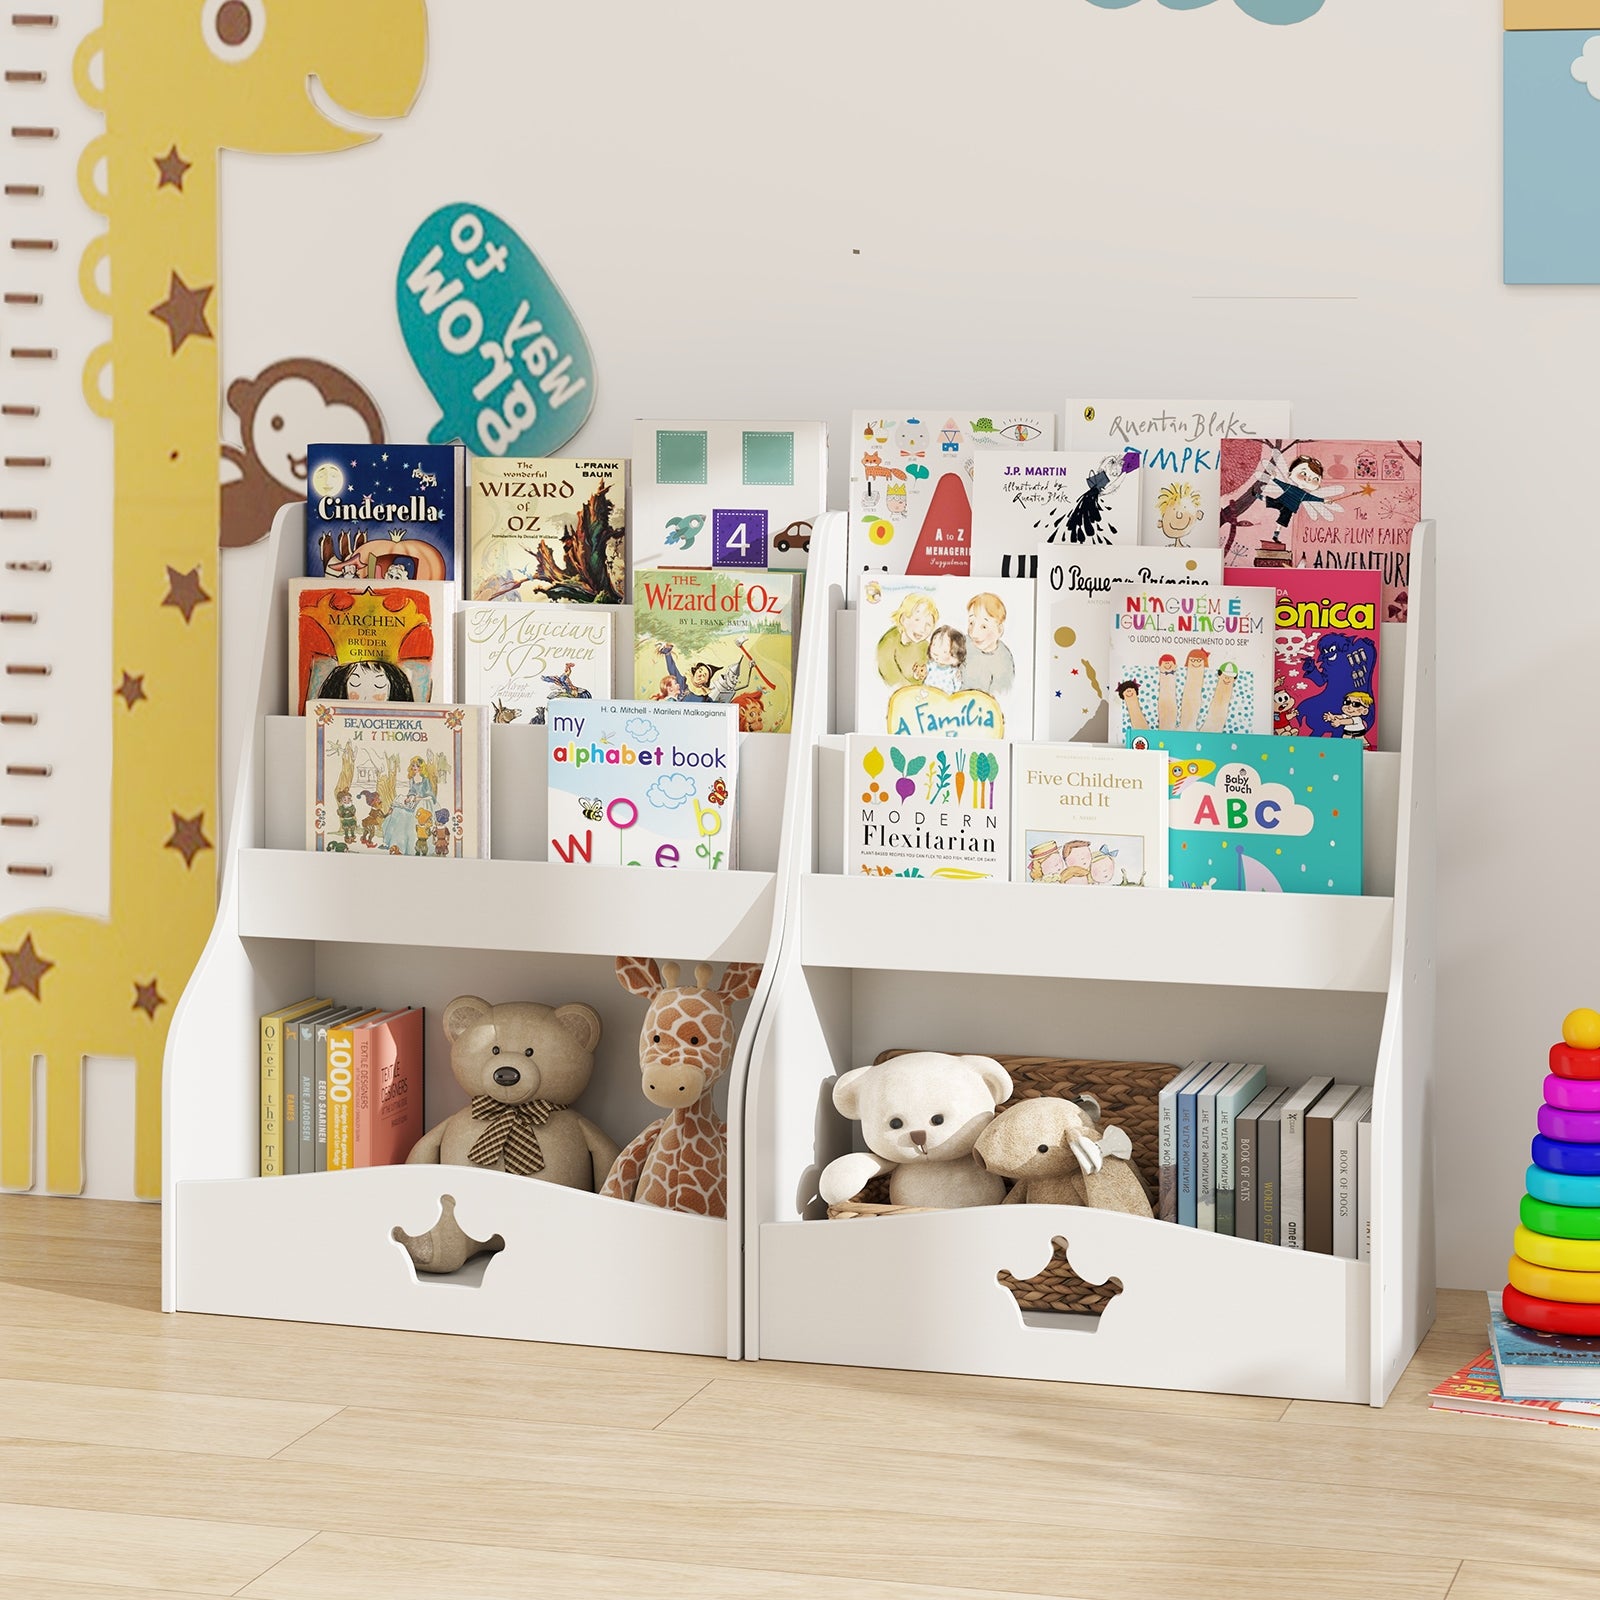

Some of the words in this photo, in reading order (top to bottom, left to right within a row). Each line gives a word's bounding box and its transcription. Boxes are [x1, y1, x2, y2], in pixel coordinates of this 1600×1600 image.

[1109, 410, 1188, 442] Quentin
[1185, 411, 1257, 442] Blake
[1004, 466, 1021, 476] J.P.
[1025, 467, 1067, 476] MARTIN
[318, 496, 438, 522] Cinderella
[517, 502, 531, 512] of
[1012, 492, 1045, 509] Quentin
[1041, 491, 1071, 505] Blake
[1354, 506, 1368, 520] The
[507, 516, 541, 532] OZ
[726, 523, 750, 557] 4
[935, 528, 943, 541] A
[957, 528, 965, 541] Z
[1303, 526, 1341, 544] SUGAR
[1344, 527, 1374, 545] PLUM
[925, 546, 971, 556] MENAGERI
[672, 576, 700, 586] THE
[1050, 565, 1064, 590] O
[643, 583, 717, 612] Wizard
[720, 583, 744, 612] of
[746, 585, 782, 615] Oz
[1276, 588, 1288, 596] DA
[1228, 596, 1241, 616] É
[328, 613, 406, 627] MÄRCHEN
[468, 610, 606, 645] Musicians
[471, 609, 499, 635] The
[727, 619, 748, 627] BAUM
[1115, 613, 1166, 631] IGUAL
[1168, 623, 1175, 632] a
[347, 637, 387, 647] BRÜDER
[357, 628, 377, 637] DER
[1137, 635, 1160, 643] LÚDICO
[1174, 636, 1223, 645] CONHECIMENTO
[1225, 638, 1235, 646] DO
[349, 649, 385, 657] GRIMM
[484, 641, 514, 671] of
[506, 638, 595, 679] Bremen
[653, 707, 681, 715] Marileni
[683, 708, 726, 718] Malkogianni
[894, 717, 911, 735] A
[915, 699, 994, 734] Família
[344, 718, 422, 730] БЕЛОСНЕЖКА
[554, 716, 585, 737] my
[353, 731, 363, 741] И
[371, 731, 377, 741] 7
[381, 731, 428, 742] ГНОМОВ
[553, 742, 664, 768] alphabet
[672, 746, 727, 768] book
[1027, 770, 1062, 786] Five
[1067, 771, 1143, 790] Children
[1224, 784, 1252, 794] Touch
[1225, 774, 1249, 787] Baby
[1059, 791, 1093, 807] and
[1098, 793, 1110, 808] It
[862, 809, 997, 829] MODERN
[864, 825, 996, 853] Flexitarian
[360, 1041, 368, 1068] TEXTILE
[330, 1038, 352, 1103] 1000
[302, 1076, 311, 1097] ARNE
[318, 1080, 327, 1100] EERO
[360, 1070, 368, 1109] DESIGNERS
[265, 1094, 274, 1132] the
[286, 1094, 295, 1122] EAMES
[302, 1099, 311, 1141] JACOBSEN
[318, 1103, 327, 1143] SAARINEN
[1240, 1138, 1250, 1161] BOOK
[1241, 1164, 1250, 1177] OF
[1340, 1149, 1348, 1174] BOOK
[1240, 1181, 1249, 1201] CATS
[1340, 1178, 1348, 1189] OF
[1264, 1182, 1273, 1212] WORLD
[1340, 1192, 1348, 1217] DOGS
[1264, 1215, 1273, 1226] OF
